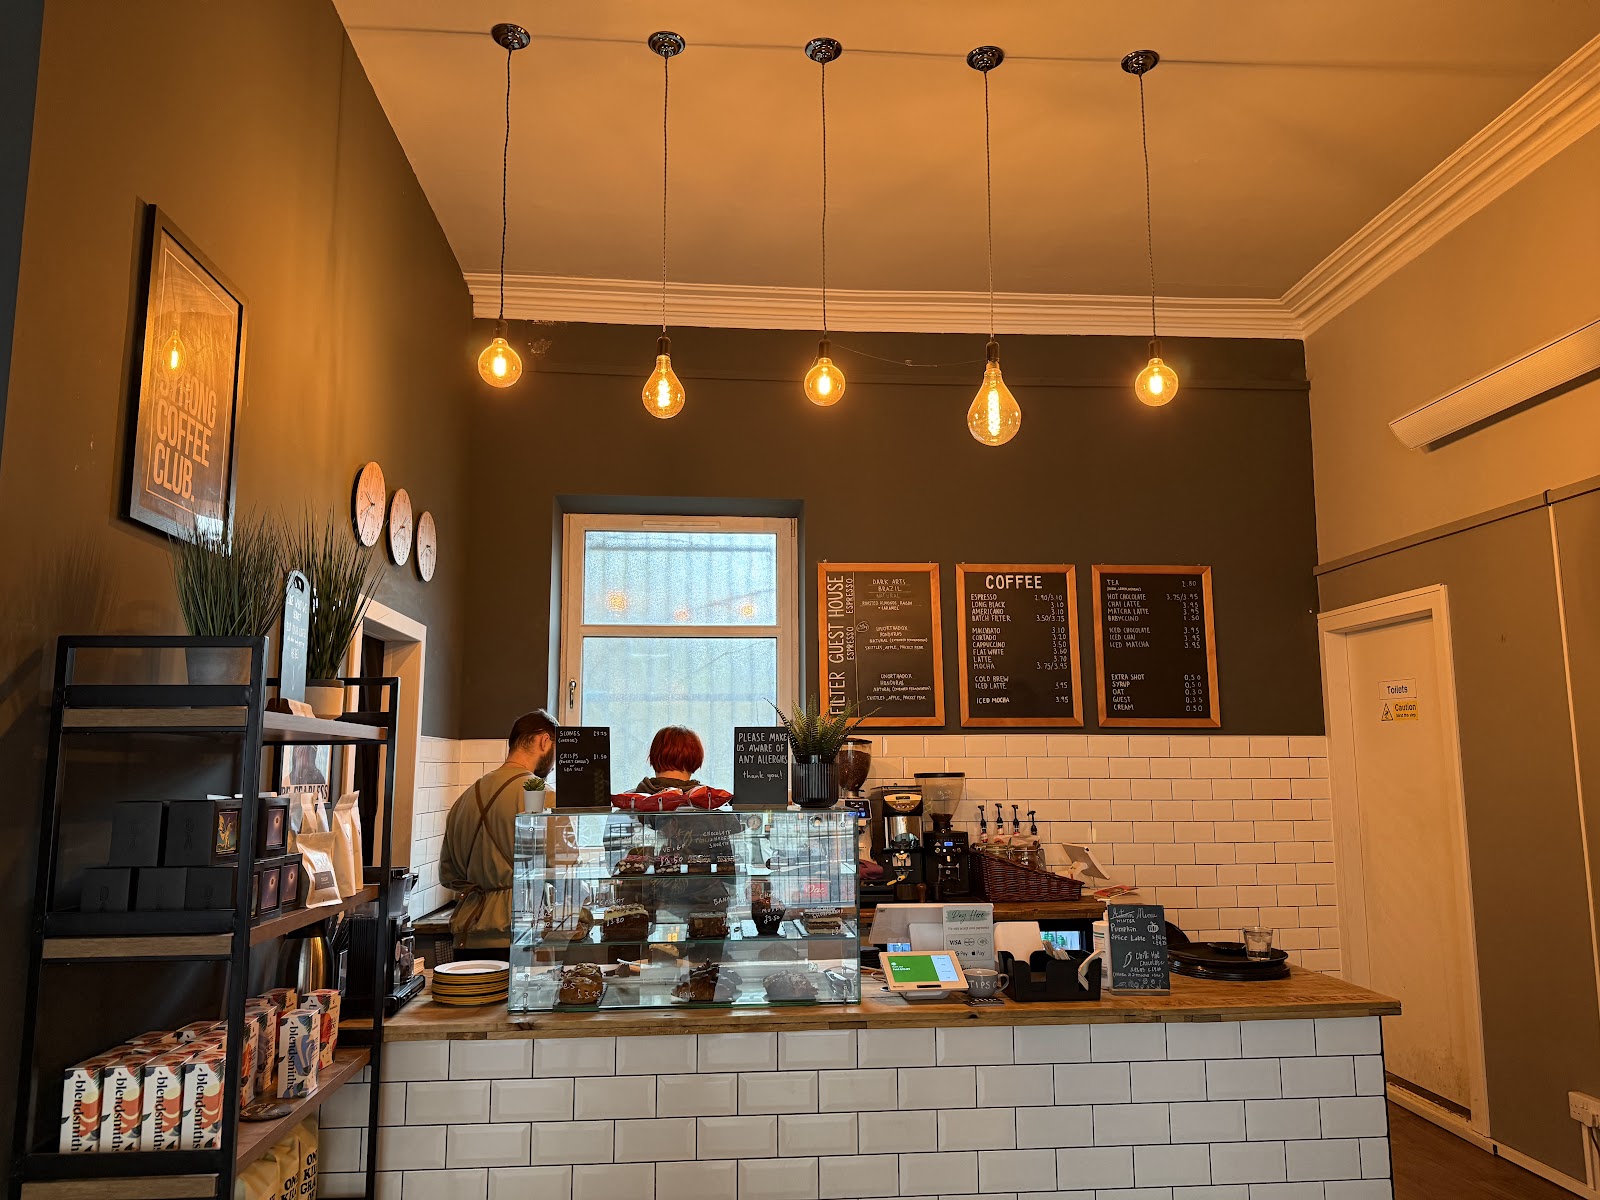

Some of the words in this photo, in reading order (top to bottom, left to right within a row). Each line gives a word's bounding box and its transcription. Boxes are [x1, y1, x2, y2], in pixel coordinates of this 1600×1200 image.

[156, 398, 212, 468] COFFEE
[153, 442, 195, 502] CLUB.
[985, 574, 1043, 590] COFFEE
[827, 575, 845, 618] HOUSE
[845, 578, 854, 614] ESPRESSO
[970, 593, 997, 601] ESPRESSO
[1106, 593, 1118, 601] HOT
[1119, 593, 1147, 601] CHOCOLATE
[1123, 600, 1141, 608] LATTE
[1107, 607, 1132, 615] MATCHA
[971, 614, 989, 622] BATCH
[991, 614, 1012, 622] FILTER
[1051, 626, 1066, 634] 3.10
[1052, 633, 1067, 641] 3.20
[1109, 633, 1122, 641] ICED
[828, 623, 845, 664] GUEST
[846, 626, 855, 661] ESPRESSO
[1052, 640, 1067, 648] 3.50
[973, 655, 993, 663] LATTE
[1053, 655, 1068, 663] 3.70
[1111, 673, 1129, 681] EXTRA
[1183, 674, 1201, 682] 0.50
[975, 682, 988, 690] ICED
[989, 682, 1007, 690] LATTE
[1386, 685, 1408, 694] Toilets
[829, 671, 846, 715] FILTER
[991, 696, 1010, 704] MOCHA
[1113, 703, 1134, 711] CREAM
[1394, 703, 1417, 712] Caution
[738, 732, 766, 742] PLEASE
[768, 732, 788, 742] MAKE
[736, 743, 745, 752] US
[748, 743, 773, 752] AWARE
[775, 743, 785, 752] OF
[738, 754, 755, 764] ANY
[757, 754, 788, 765] ALLERGIES
[742, 769, 765, 779] thank
[766, 769, 783, 782] you!
[951, 909, 967, 924] Pay
[969, 909, 985, 921] Here
[1136, 907, 1158, 919] Menu
[1110, 922, 1137, 933] Pumpkin
[1130, 934, 1146, 942] Latte
[968, 980, 991, 989] TIPS
[287, 1026, 299, 1090] blendsmiths
[71, 1076, 86, 1152] blendsmith
[192, 1073, 208, 1149] blendsmiths
